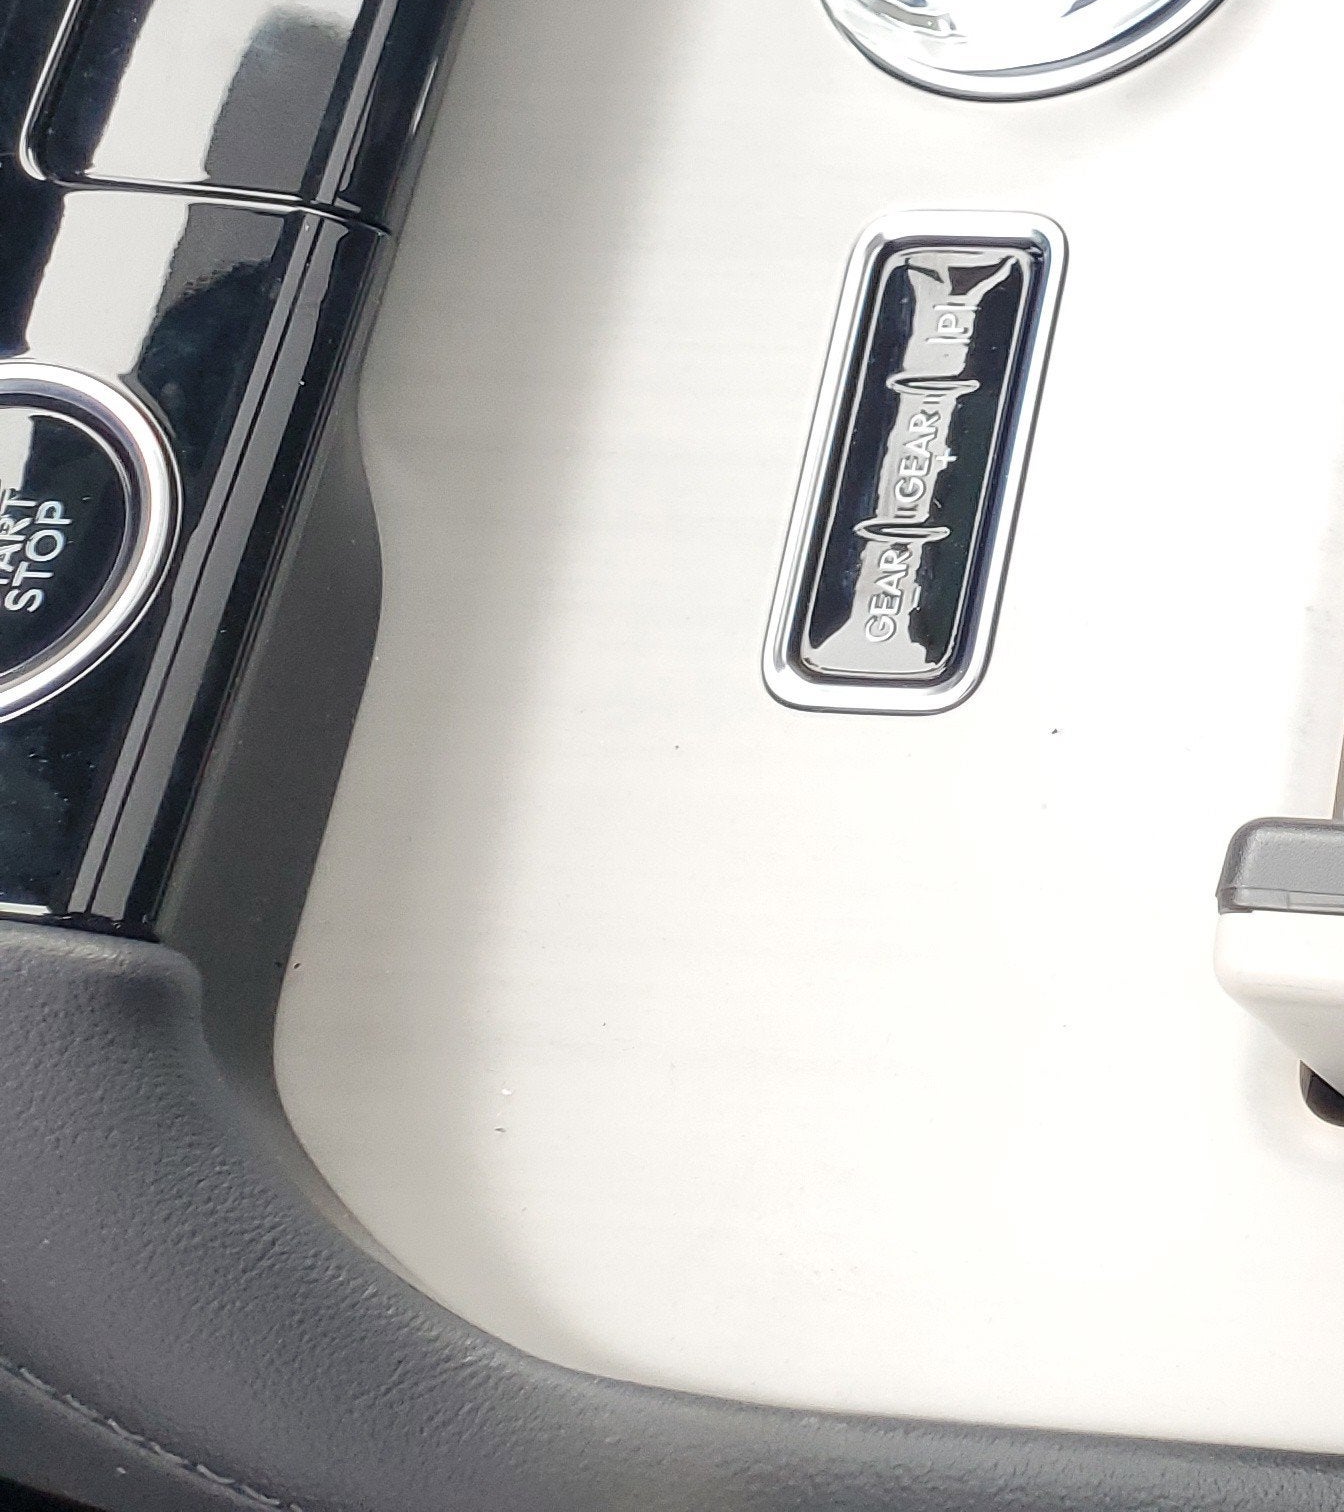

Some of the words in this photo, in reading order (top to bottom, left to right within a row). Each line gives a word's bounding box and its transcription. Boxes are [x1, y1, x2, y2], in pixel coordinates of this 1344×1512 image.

[894, 409, 942, 504] GEAR
[0, 488, 38, 586] ART
[4, 499, 73, 613] STOP
[865, 548, 912, 643] GEAR
